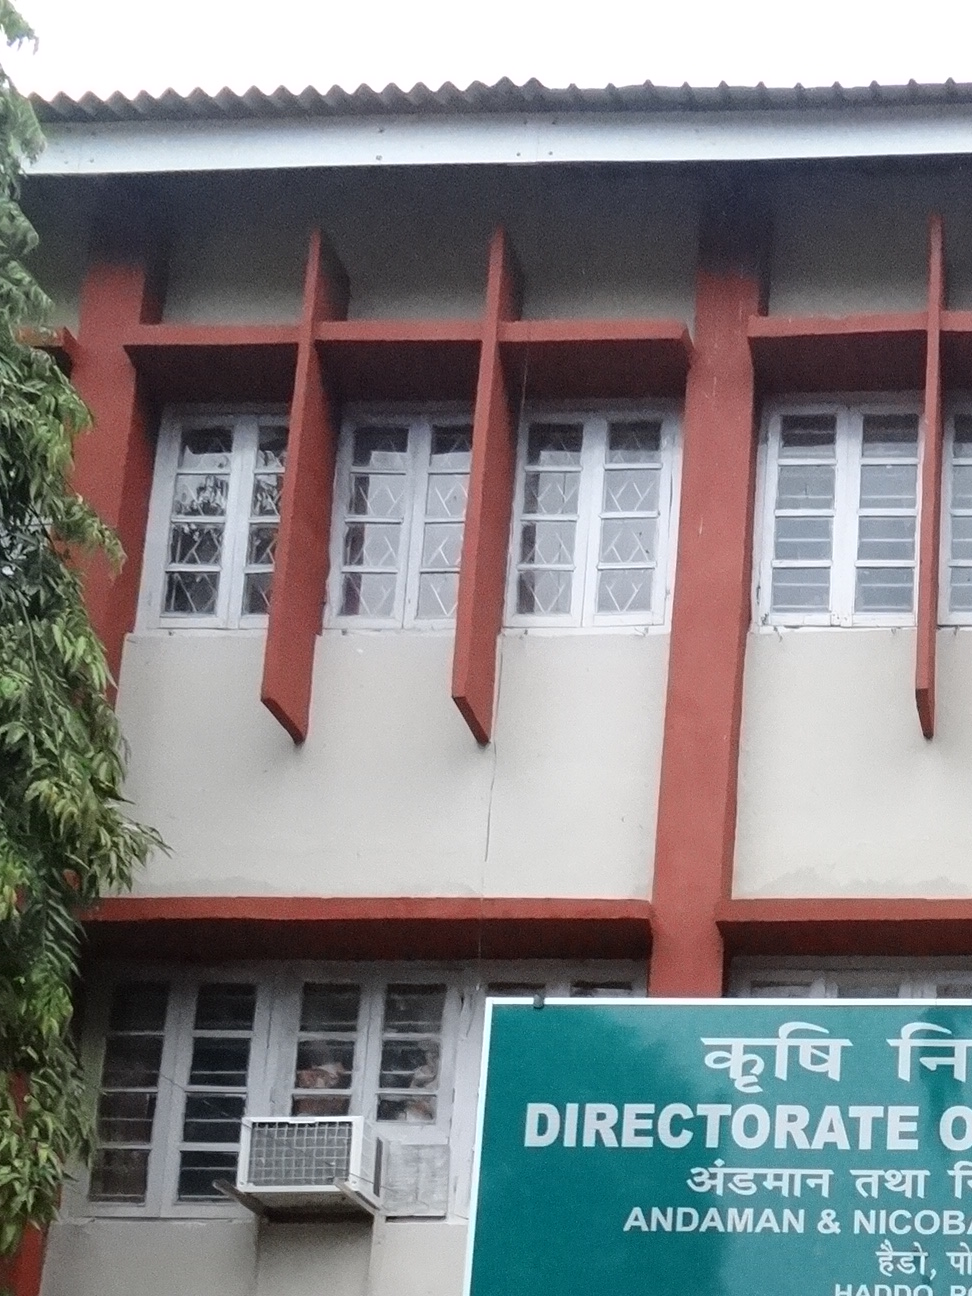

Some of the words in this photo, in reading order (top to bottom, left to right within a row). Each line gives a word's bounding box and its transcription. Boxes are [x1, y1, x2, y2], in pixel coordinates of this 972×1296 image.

[700, 1021, 853, 1094] कृषि
[524, 1103, 920, 1151] DIRECTORATE
[687, 1158, 835, 1198] अंडमान
[849, 1169, 931, 1199] तथा
[623, 1206, 806, 1234] ANDAMAN
[816, 1208, 841, 1235] &
[875, 1238, 937, 1280] हैडो,
